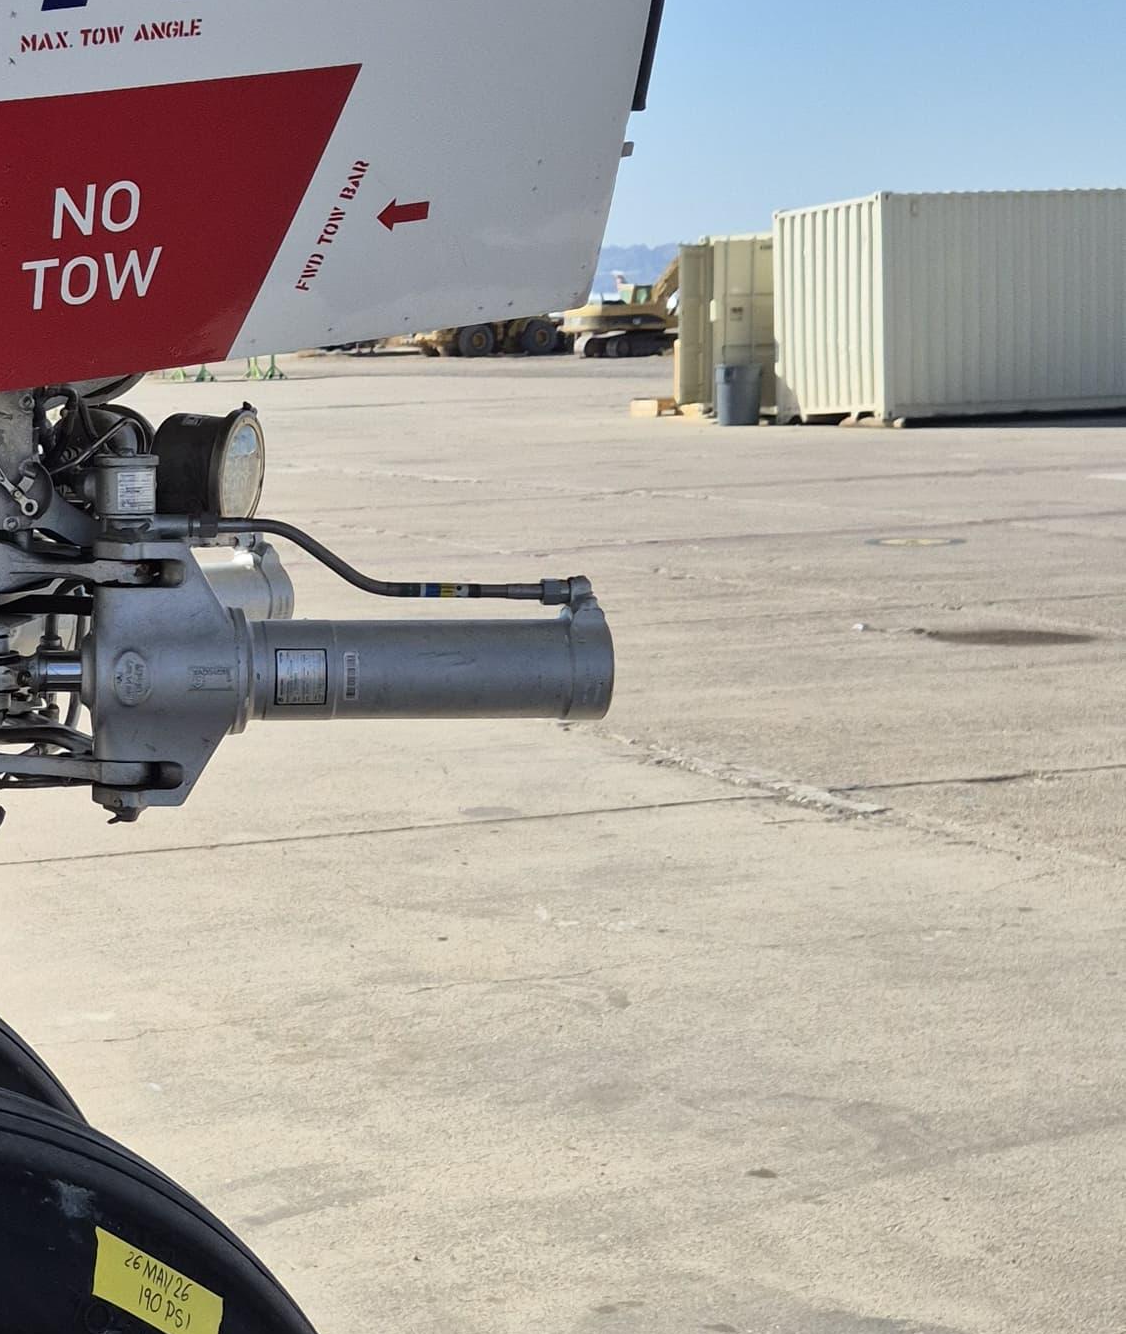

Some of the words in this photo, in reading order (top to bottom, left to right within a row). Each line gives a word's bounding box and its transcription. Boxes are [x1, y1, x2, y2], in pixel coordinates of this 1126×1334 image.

[21, 32, 73, 53] MAX.
[80, 26, 124, 46] TOW
[133, 19, 202, 42] ANGLE
[53, 179, 142, 240] NO
[295, 253, 324, 291] FWD
[317, 206, 346, 244] TOW
[338, 160, 370, 200] BAR
[21, 246, 163, 311] TOW
[124, 1251, 143, 1270] 26
[173, 1277, 193, 1302] 26
[138, 1285, 163, 1313] 190
[165, 1300, 191, 1331] PSI
